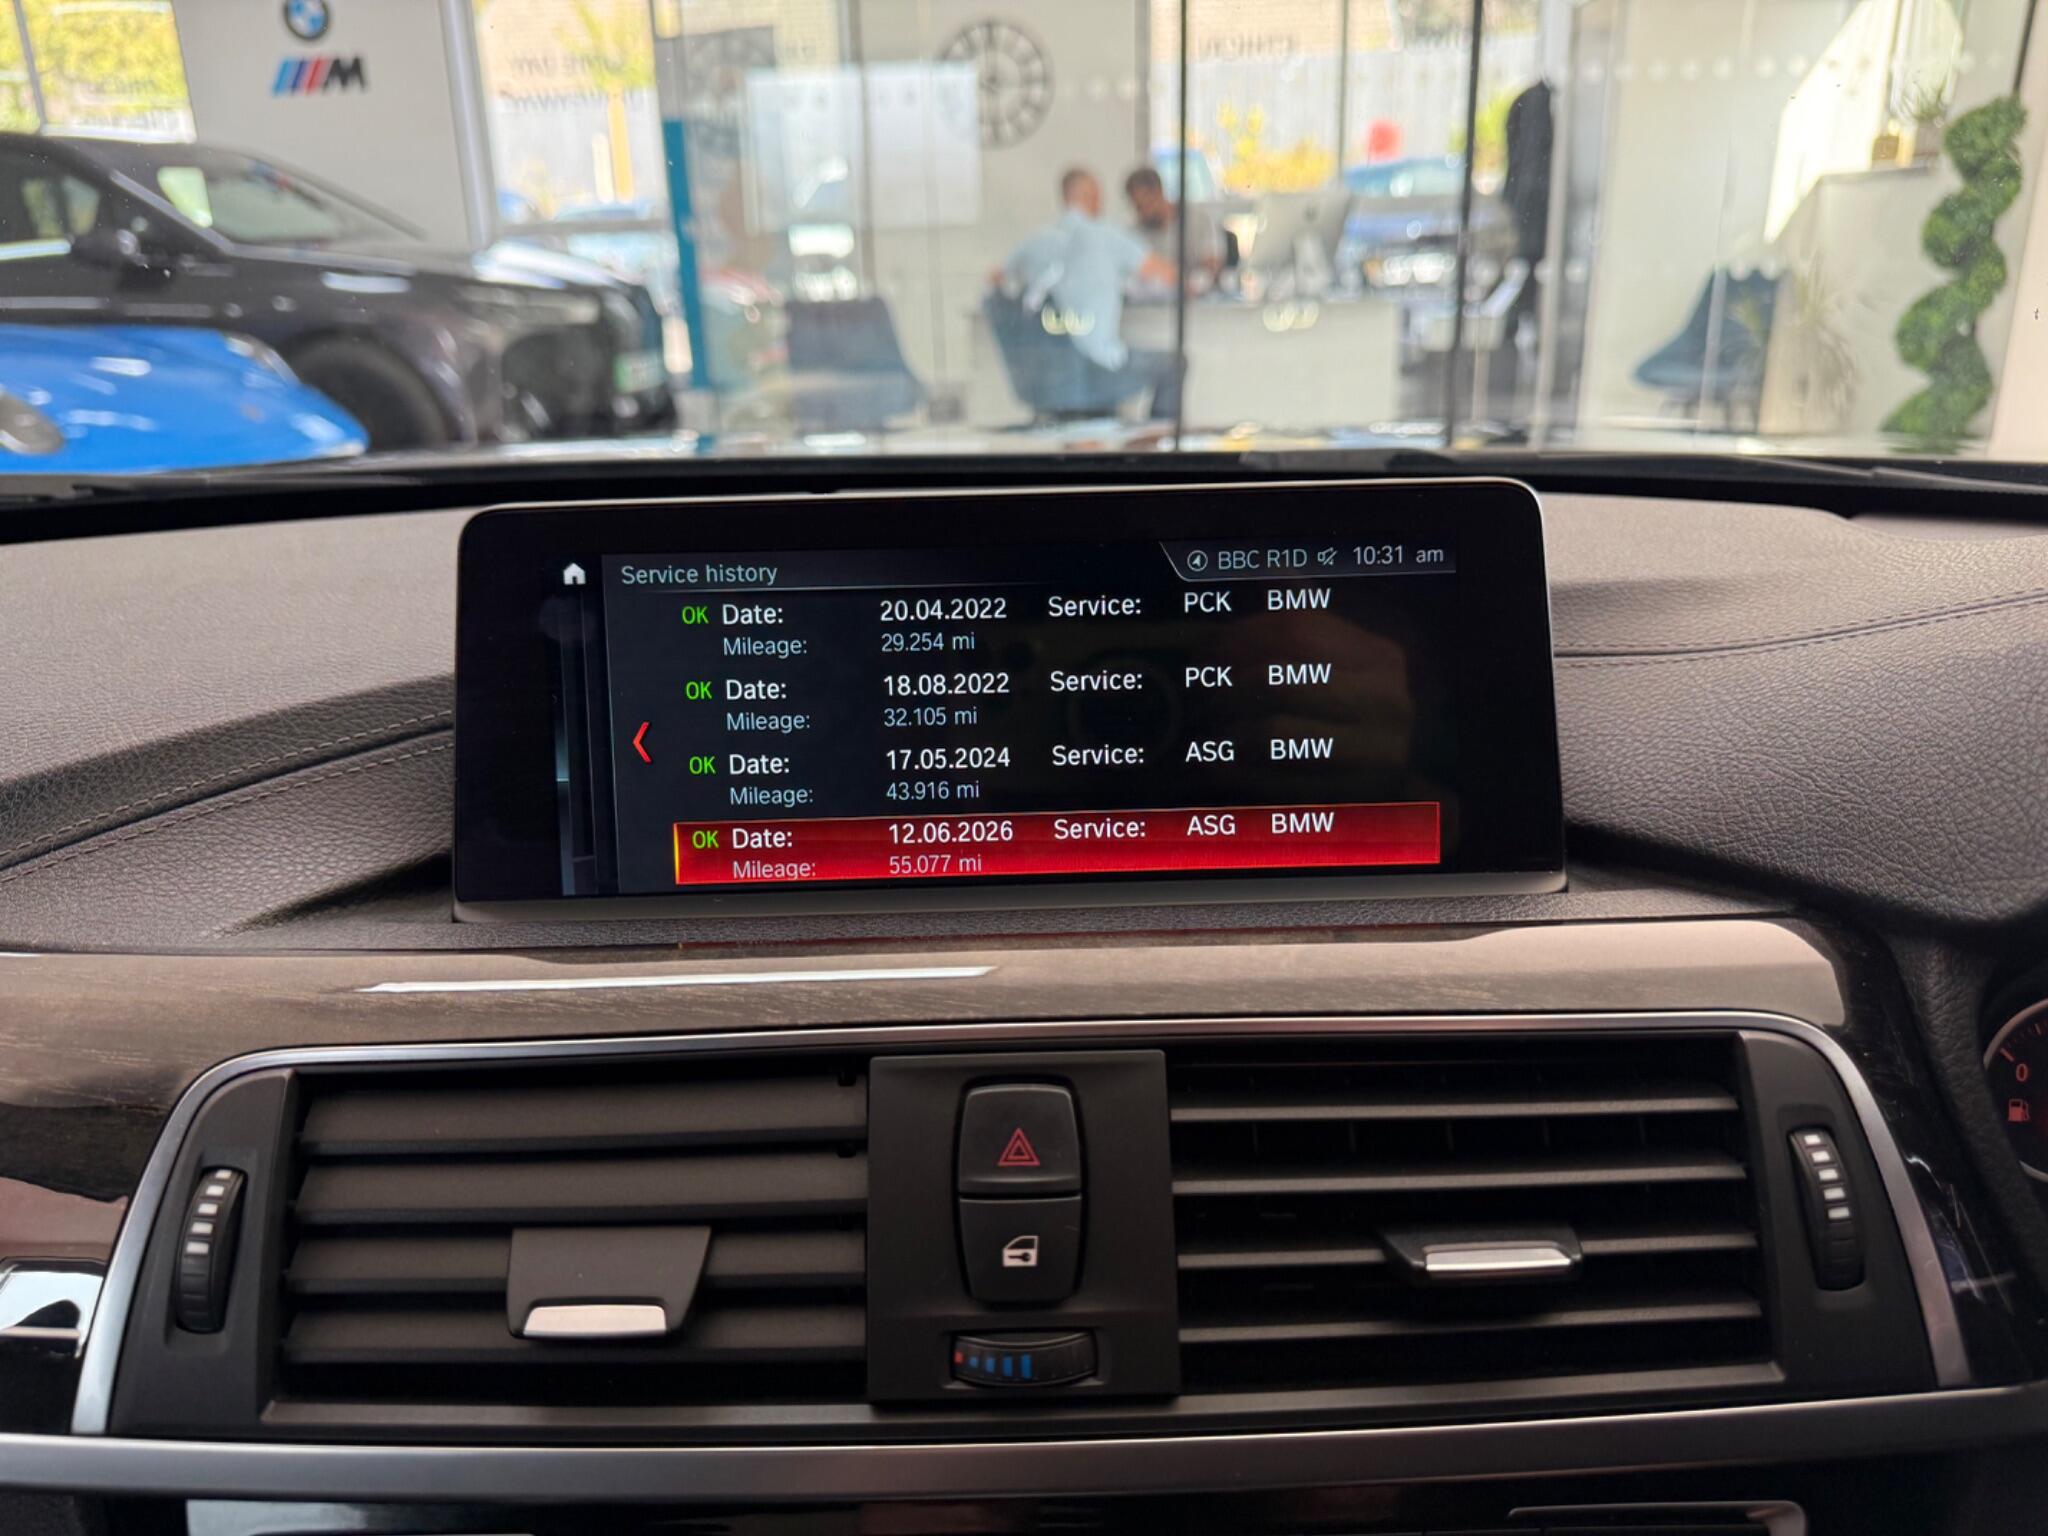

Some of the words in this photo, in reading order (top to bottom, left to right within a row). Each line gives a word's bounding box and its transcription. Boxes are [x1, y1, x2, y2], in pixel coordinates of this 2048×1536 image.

[1219, 550, 1259, 569] BBC
[1268, 549, 1307, 568] R1D
[1354, 545, 1402, 564] 10:31
[1416, 549, 1443, 563] am
[622, 565, 698, 584] Service
[706, 564, 777, 585] history
[682, 607, 708, 624] OK
[723, 604, 783, 624] Date:
[881, 598, 1006, 621] 20.04.2022
[1049, 595, 1140, 616] Service:
[1185, 592, 1231, 612] PCK
[1268, 589, 1330, 610] BMW
[724, 637, 806, 658] Mileage:
[882, 632, 944, 651] 29.254
[953, 632, 974, 650] mi
[686, 682, 712, 699] OK
[727, 680, 786, 699] Date:
[884, 672, 1009, 695] 18.08.2022
[1051, 670, 1142, 691] Service:
[1186, 667, 1232, 687] PCK
[1269, 664, 1331, 685] BMW
[727, 712, 809, 733] Mileage:
[884, 707, 946, 727] 32.105
[955, 706, 976, 724] mi
[690, 756, 715, 774] OK
[730, 754, 789, 774] Date:
[887, 747, 1010, 770] 17.05.2024
[1053, 744, 1143, 765] Service:
[1186, 741, 1234, 762] ASG
[1271, 738, 1333, 759] BMW
[730, 787, 812, 807] Mileage:
[886, 781, 949, 800] 43.916
[957, 781, 979, 798] mi
[693, 831, 719, 848] OK
[733, 828, 792, 848] Date:
[888, 821, 1013, 843] 12.06.2026
[1055, 818, 1145, 839] Service:
[1187, 815, 1235, 835] ASG
[1272, 812, 1334, 833] BMW
[733, 861, 815, 880] Mileage:
[890, 855, 951, 874] 55.077
[959, 854, 981, 872] mi
[2016, 1063, 2028, 1082] 0
